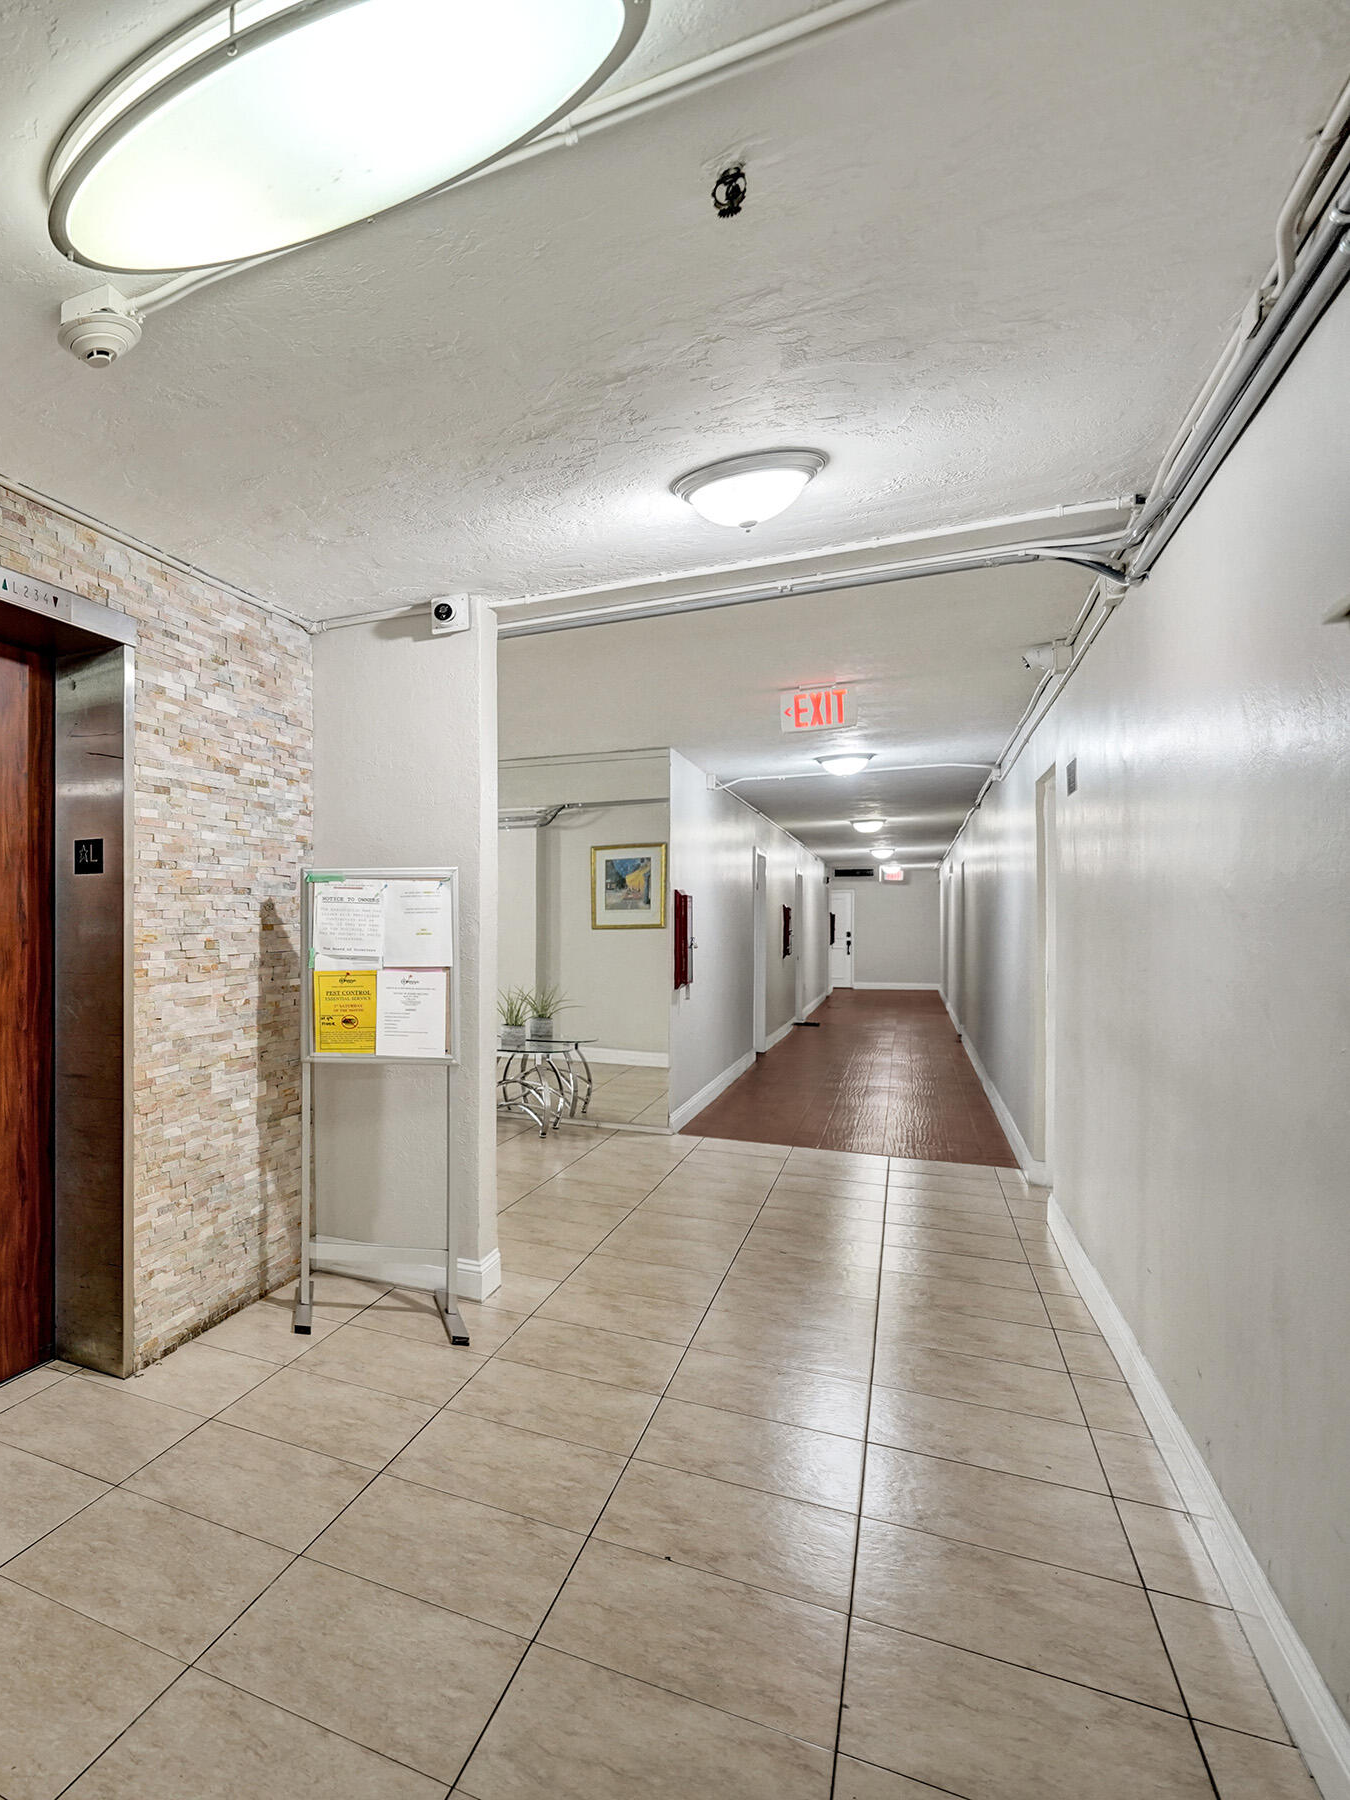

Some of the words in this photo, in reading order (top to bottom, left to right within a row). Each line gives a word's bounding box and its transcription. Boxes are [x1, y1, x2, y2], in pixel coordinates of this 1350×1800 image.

[12, 581, 19, 595] L
[24, 585, 29, 599] 2
[34, 588, 39, 602] 3
[43, 592, 49, 605] 4
[793, 689, 848, 729] EXIT
[90, 843, 99, 863] L
[342, 989, 371, 997] CONTROL
